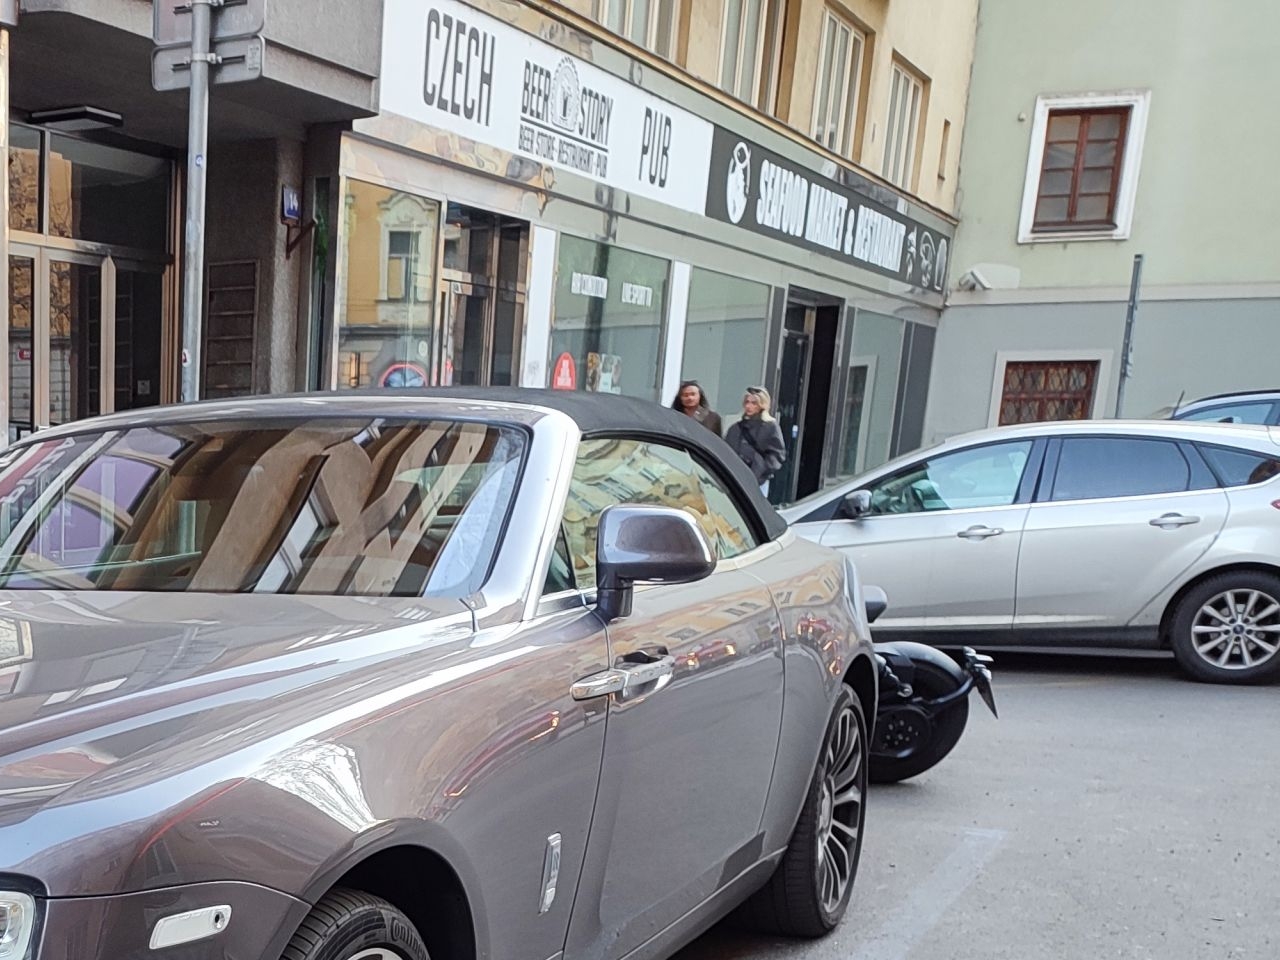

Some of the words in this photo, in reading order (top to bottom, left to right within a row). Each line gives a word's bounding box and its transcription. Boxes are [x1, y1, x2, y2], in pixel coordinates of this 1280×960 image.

[423, 8, 496, 126] CZECH
[521, 60, 552, 123] BEER
[578, 87, 615, 146] STORY
[518, 124, 534, 154] BEER
[638, 106, 672, 188] PUB
[756, 159, 809, 238] SEAFOOD
[805, 182, 848, 252] MARKET
